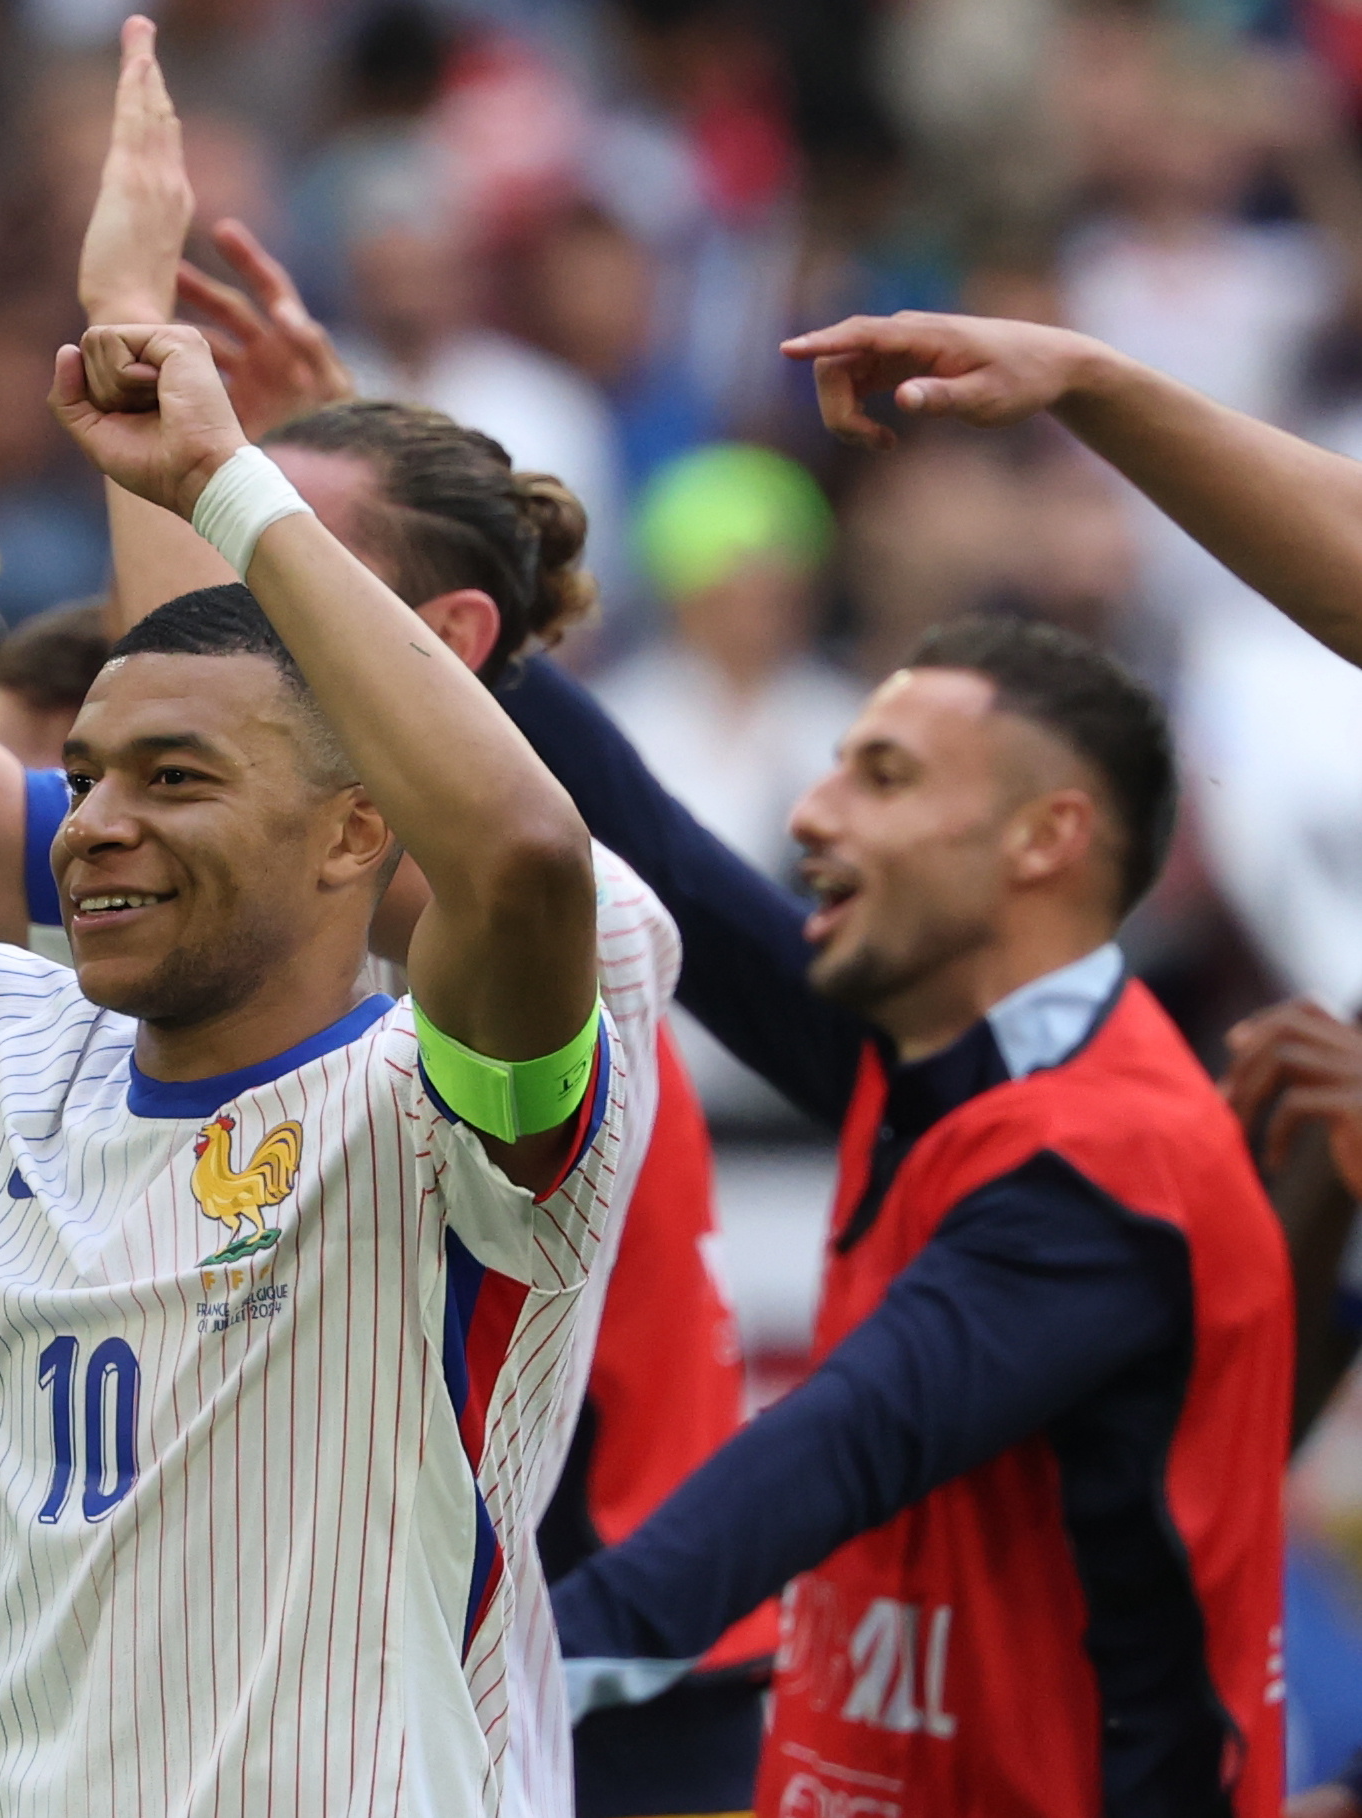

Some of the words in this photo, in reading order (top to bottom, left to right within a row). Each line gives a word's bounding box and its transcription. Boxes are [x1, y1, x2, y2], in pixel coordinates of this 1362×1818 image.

[196, 1302, 230, 1317] FRANCE
[242, 1284, 288, 1305] LGIQUE
[250, 1302, 282, 1320] 2024
[38, 1335, 140, 1525] 10
